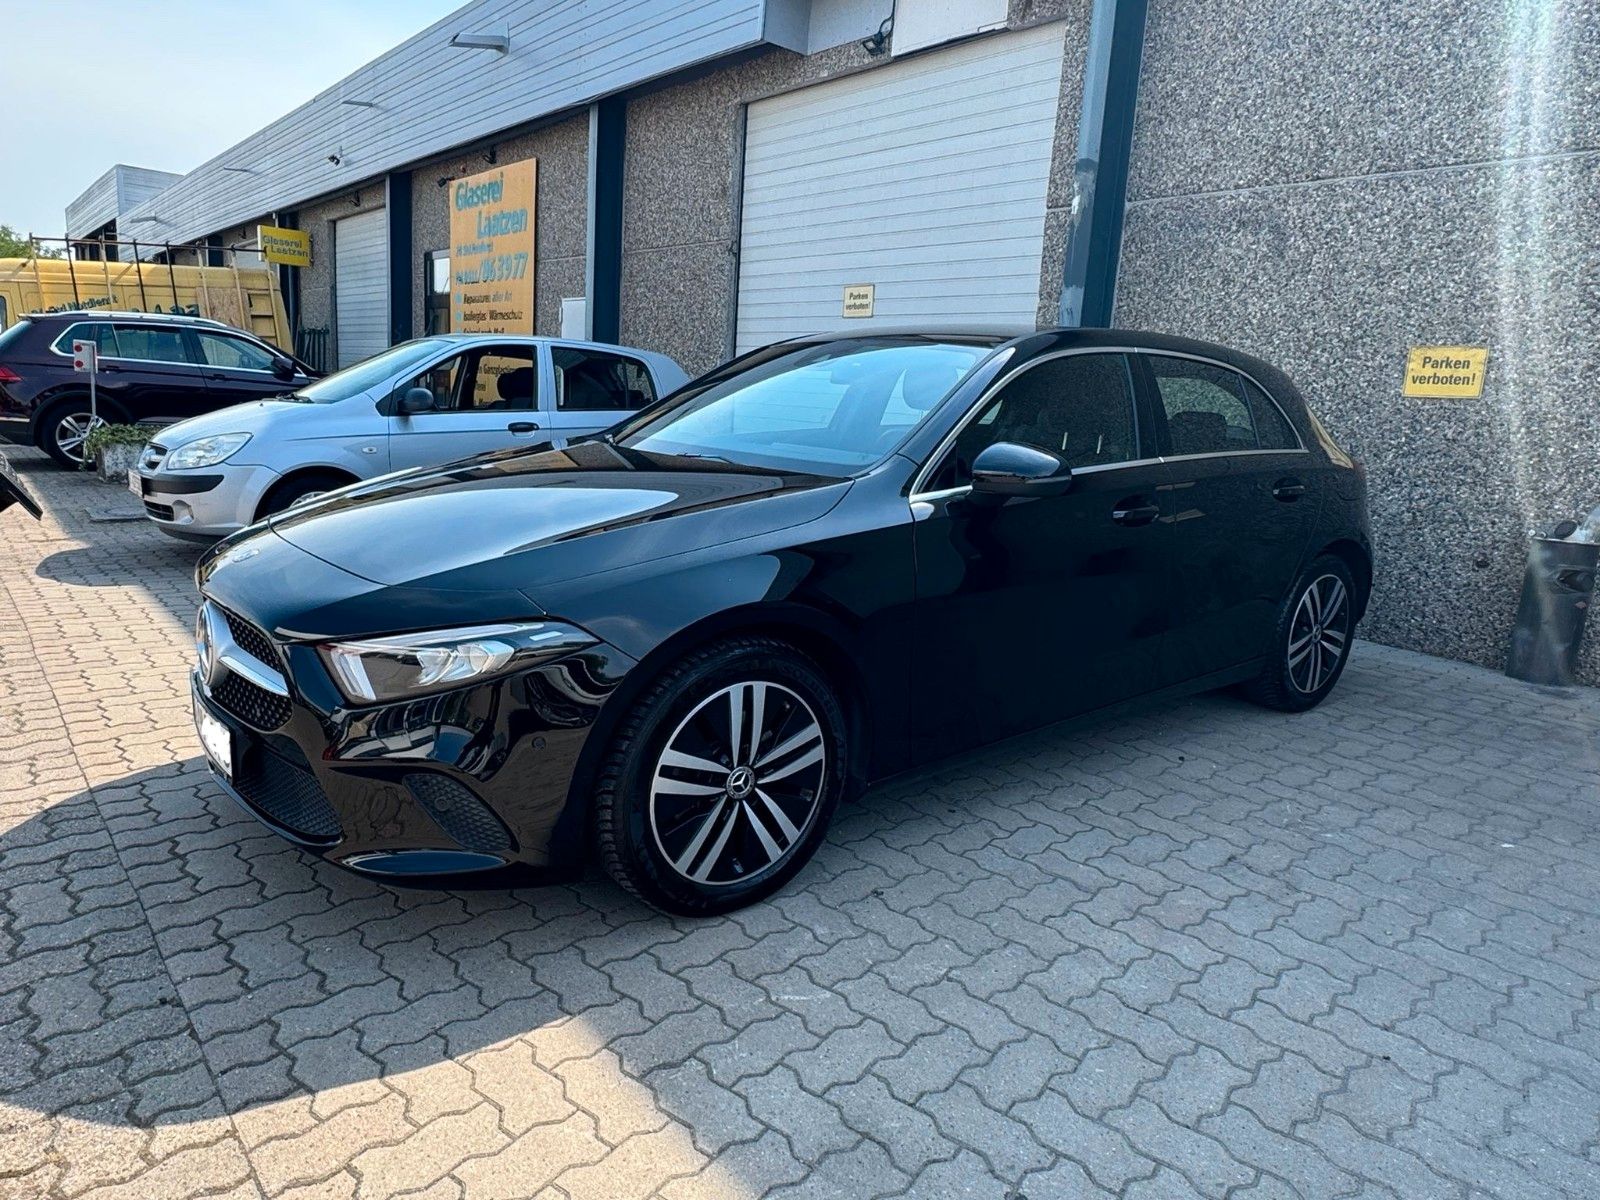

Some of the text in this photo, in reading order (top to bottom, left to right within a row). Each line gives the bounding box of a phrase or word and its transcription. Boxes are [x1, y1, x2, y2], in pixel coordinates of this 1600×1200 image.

[456, 172, 503, 211] Glaserei
[477, 208, 528, 239] Laatzen
[263, 235, 302, 248] Glaserei
[271, 245, 309, 257] Laatzen
[1422, 356, 1471, 369] Parken
[1411, 372, 1476, 386] verboten!
